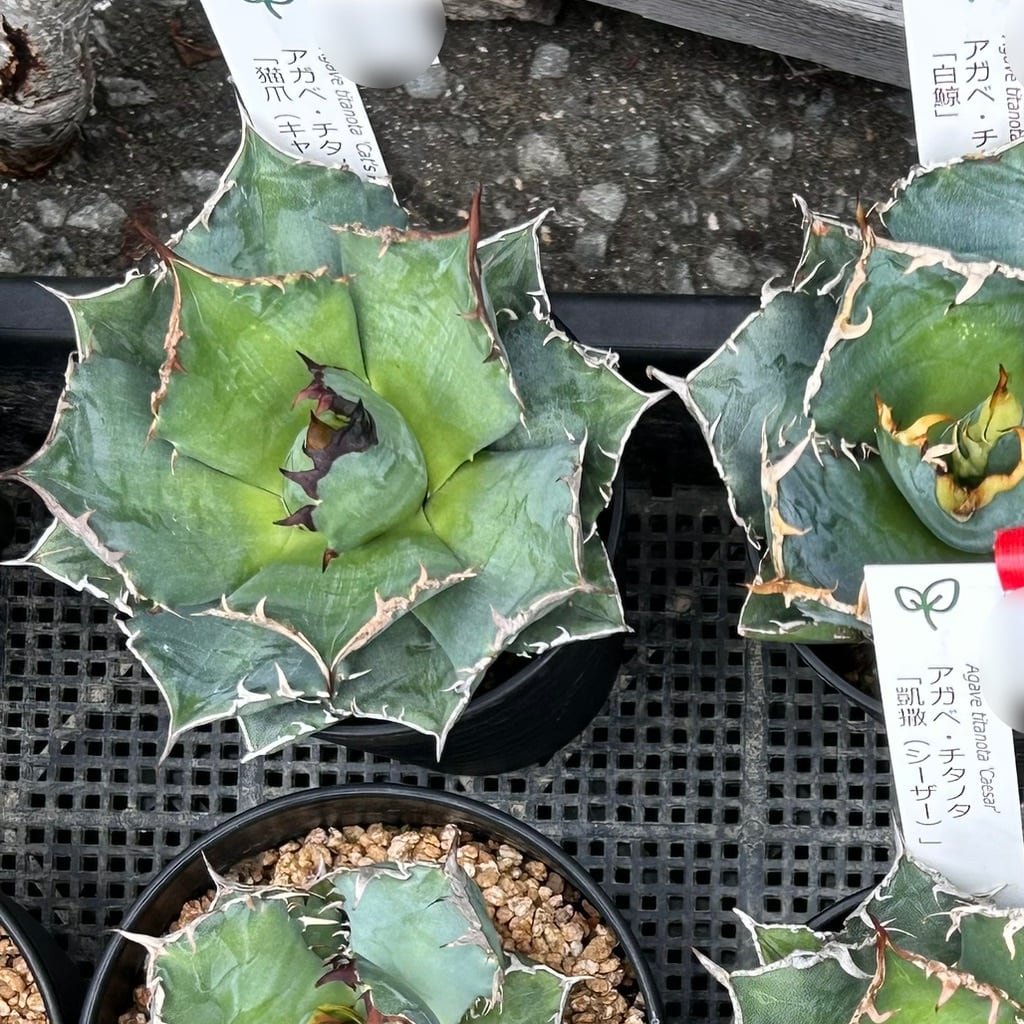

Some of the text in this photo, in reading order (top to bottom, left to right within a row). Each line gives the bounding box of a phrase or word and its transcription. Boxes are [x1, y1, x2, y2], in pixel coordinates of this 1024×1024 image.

[281, 49, 347, 164] アガベ・チタ
[317, 46, 345, 86] gave
[336, 89, 364, 136] titanota
[356, 141, 379, 173] 'Cat's
[931, 52, 962, 118] 「白鯨」
[963, 39, 998, 148] アガベ・チ
[1005, 86, 1024, 142] titanota
[963, 663, 983, 707] Agave
[927, 666, 971, 819] アガベ・チタノタ
[971, 712, 992, 762] titanota
